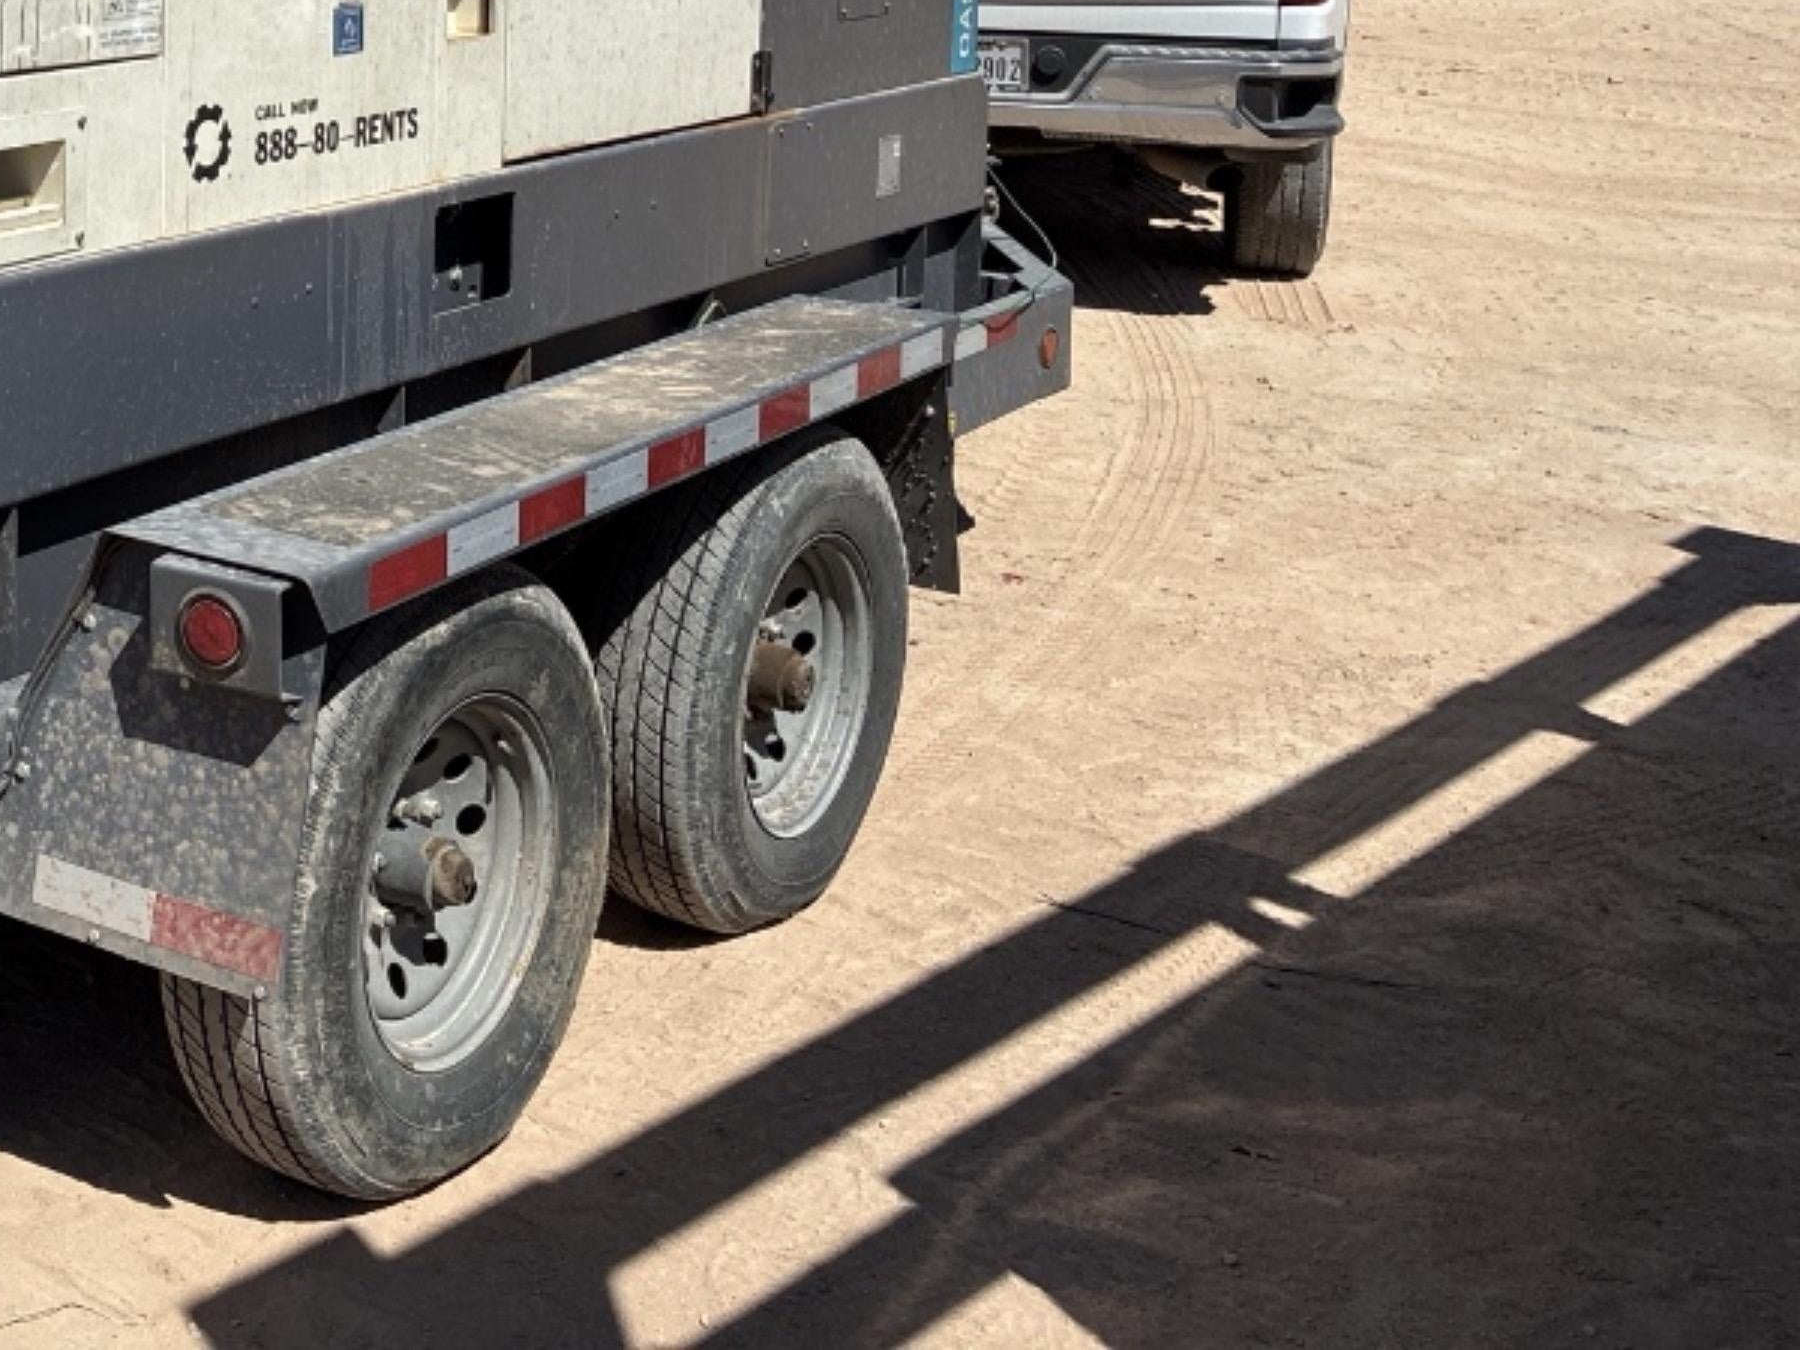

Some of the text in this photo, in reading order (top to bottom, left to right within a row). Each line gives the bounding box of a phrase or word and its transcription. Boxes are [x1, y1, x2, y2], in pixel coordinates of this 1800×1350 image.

[255, 98, 319, 121] CALL NOW
[255, 107, 419, 165] 888-80-RENTS
